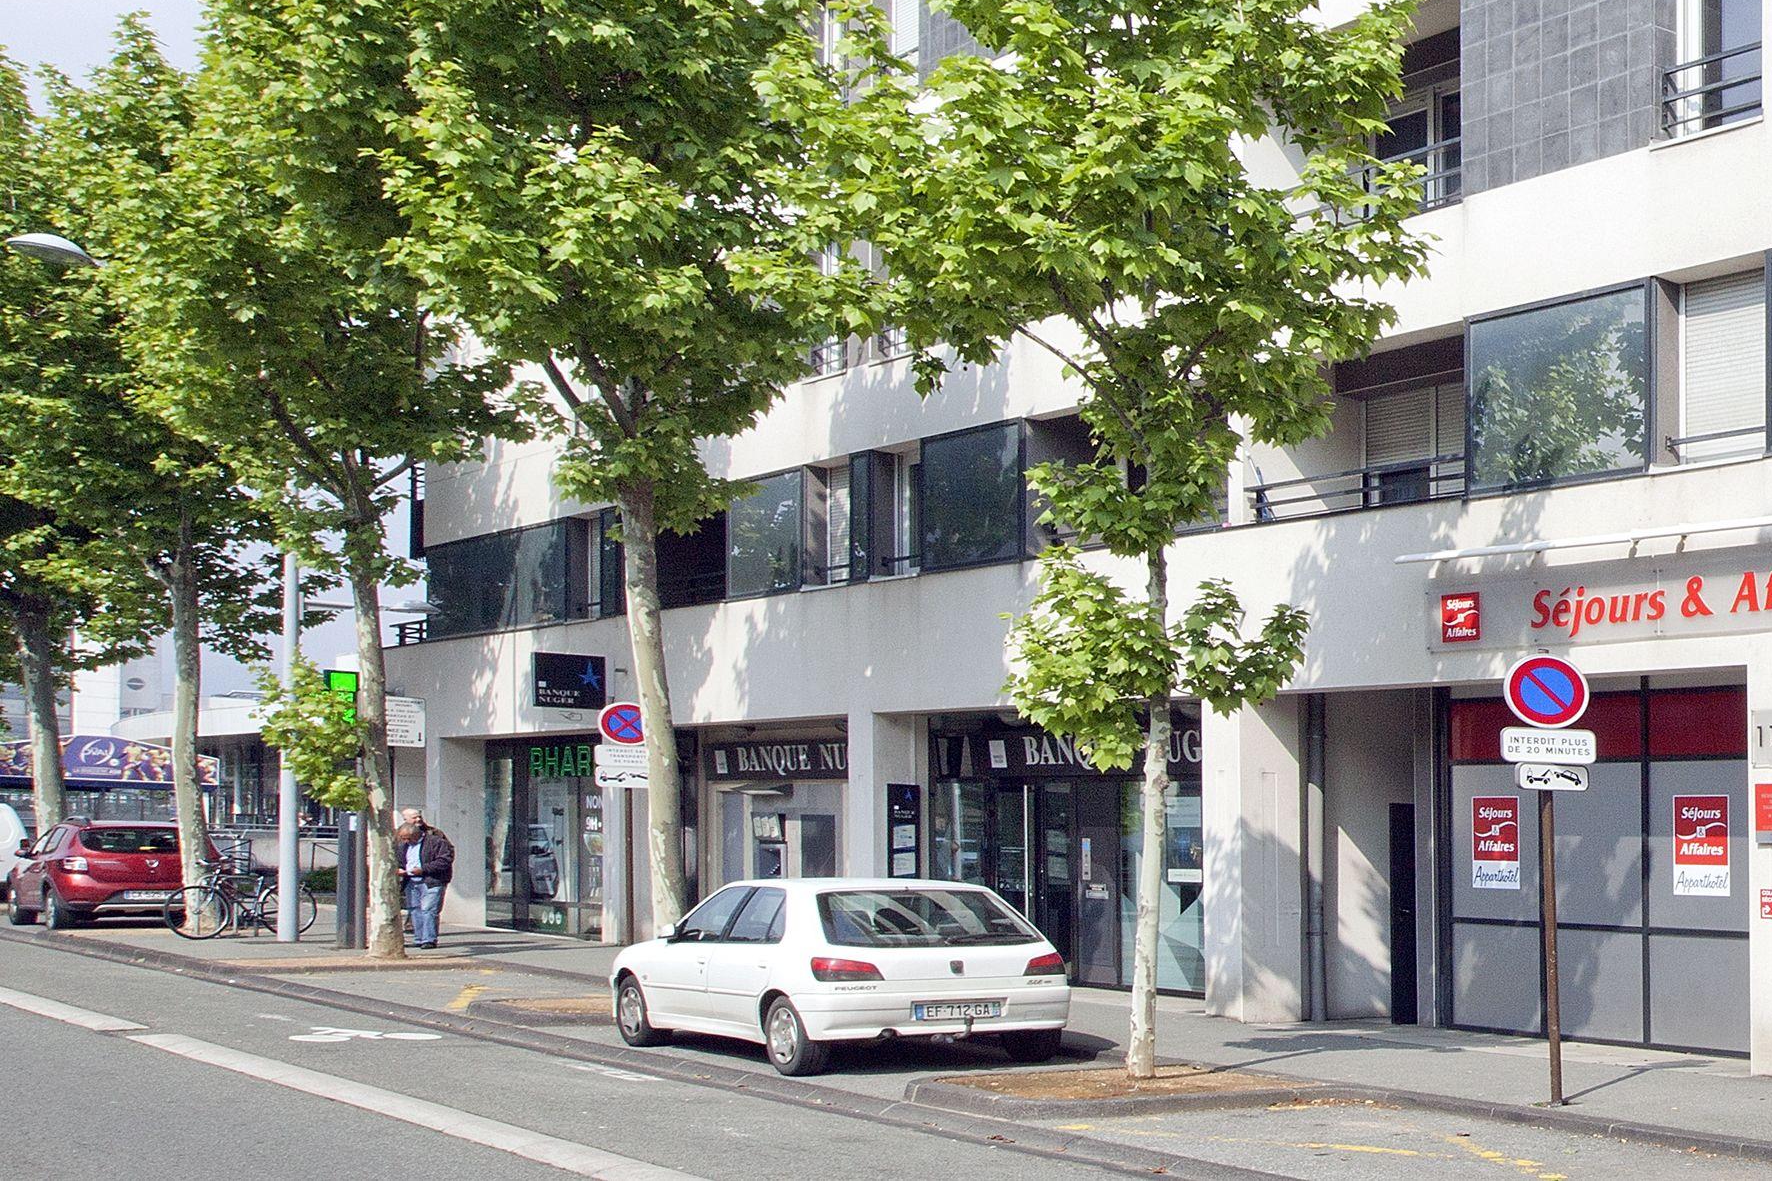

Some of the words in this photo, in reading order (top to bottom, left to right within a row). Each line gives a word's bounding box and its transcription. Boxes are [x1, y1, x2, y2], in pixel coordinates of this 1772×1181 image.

[1446, 599, 1475, 611] Séjours
[1530, 586, 1665, 639] Séjours
[1680, 575, 1714, 618] &
[1446, 627, 1477, 638] Affaires
[538, 689, 580, 697] BANQUE
[538, 696, 575, 704] NUGER
[1509, 736, 1556, 746] INTERDIT
[1561, 738, 1588, 747] PLUS
[1508, 746, 1521, 754] DE
[1526, 746, 1540, 754] 20
[1545, 747, 1591, 756] MINUTES
[530, 745, 591, 777] PHAR
[735, 744, 812, 776] BANQUE
[818, 743, 847, 770] NU
[1478, 806, 1513, 819] Séjours
[1681, 807, 1722, 820] Séjours
[1477, 840, 1515, 853] Affaires
[1679, 843, 1724, 857] Affaires
[1474, 865, 1520, 886] Apparthotel
[1676, 870, 1729, 892] Apparthotel
